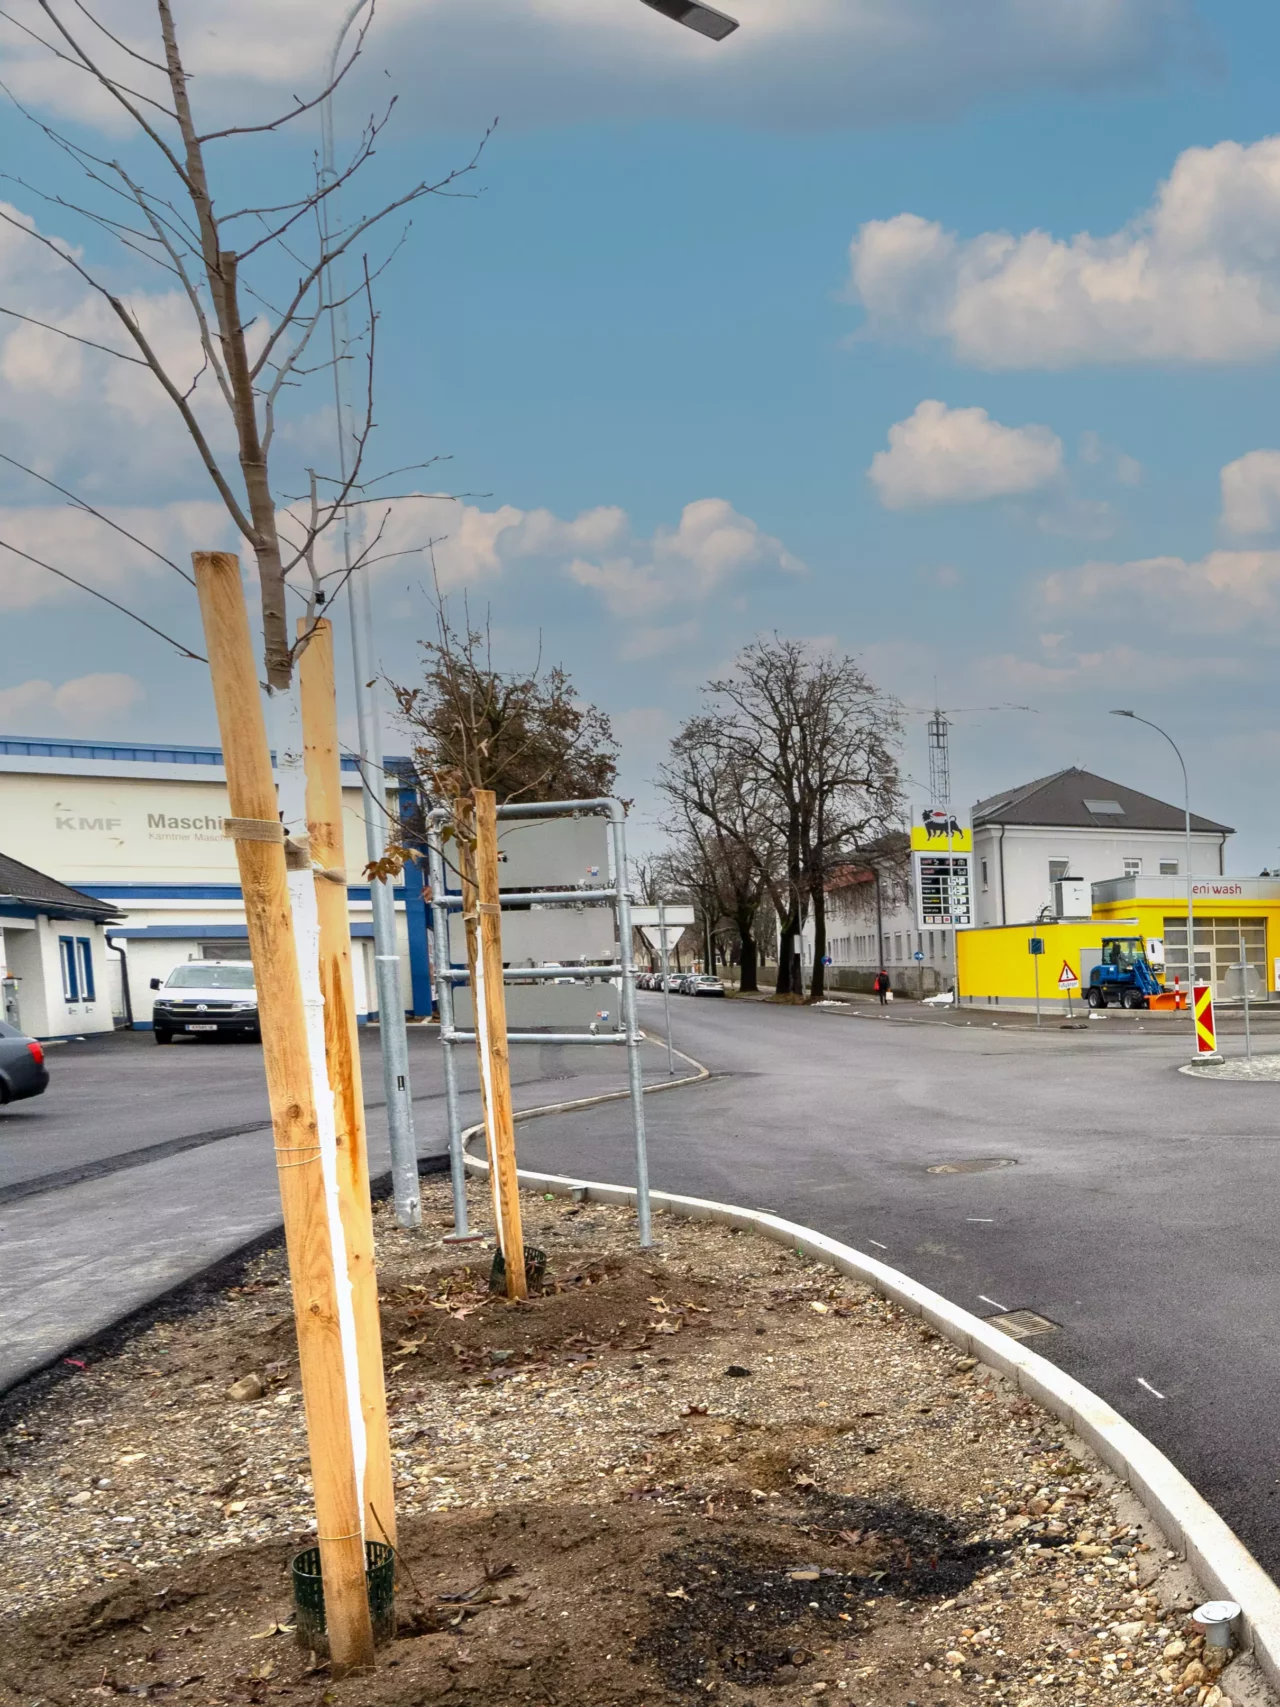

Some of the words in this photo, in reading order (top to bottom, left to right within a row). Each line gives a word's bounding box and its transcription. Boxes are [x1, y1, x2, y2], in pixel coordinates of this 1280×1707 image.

[54, 817, 122, 831] KMF
[147, 813, 224, 830] Maschi
[1192, 882, 1209, 894] eni
[1212, 883, 1242, 894] wash
